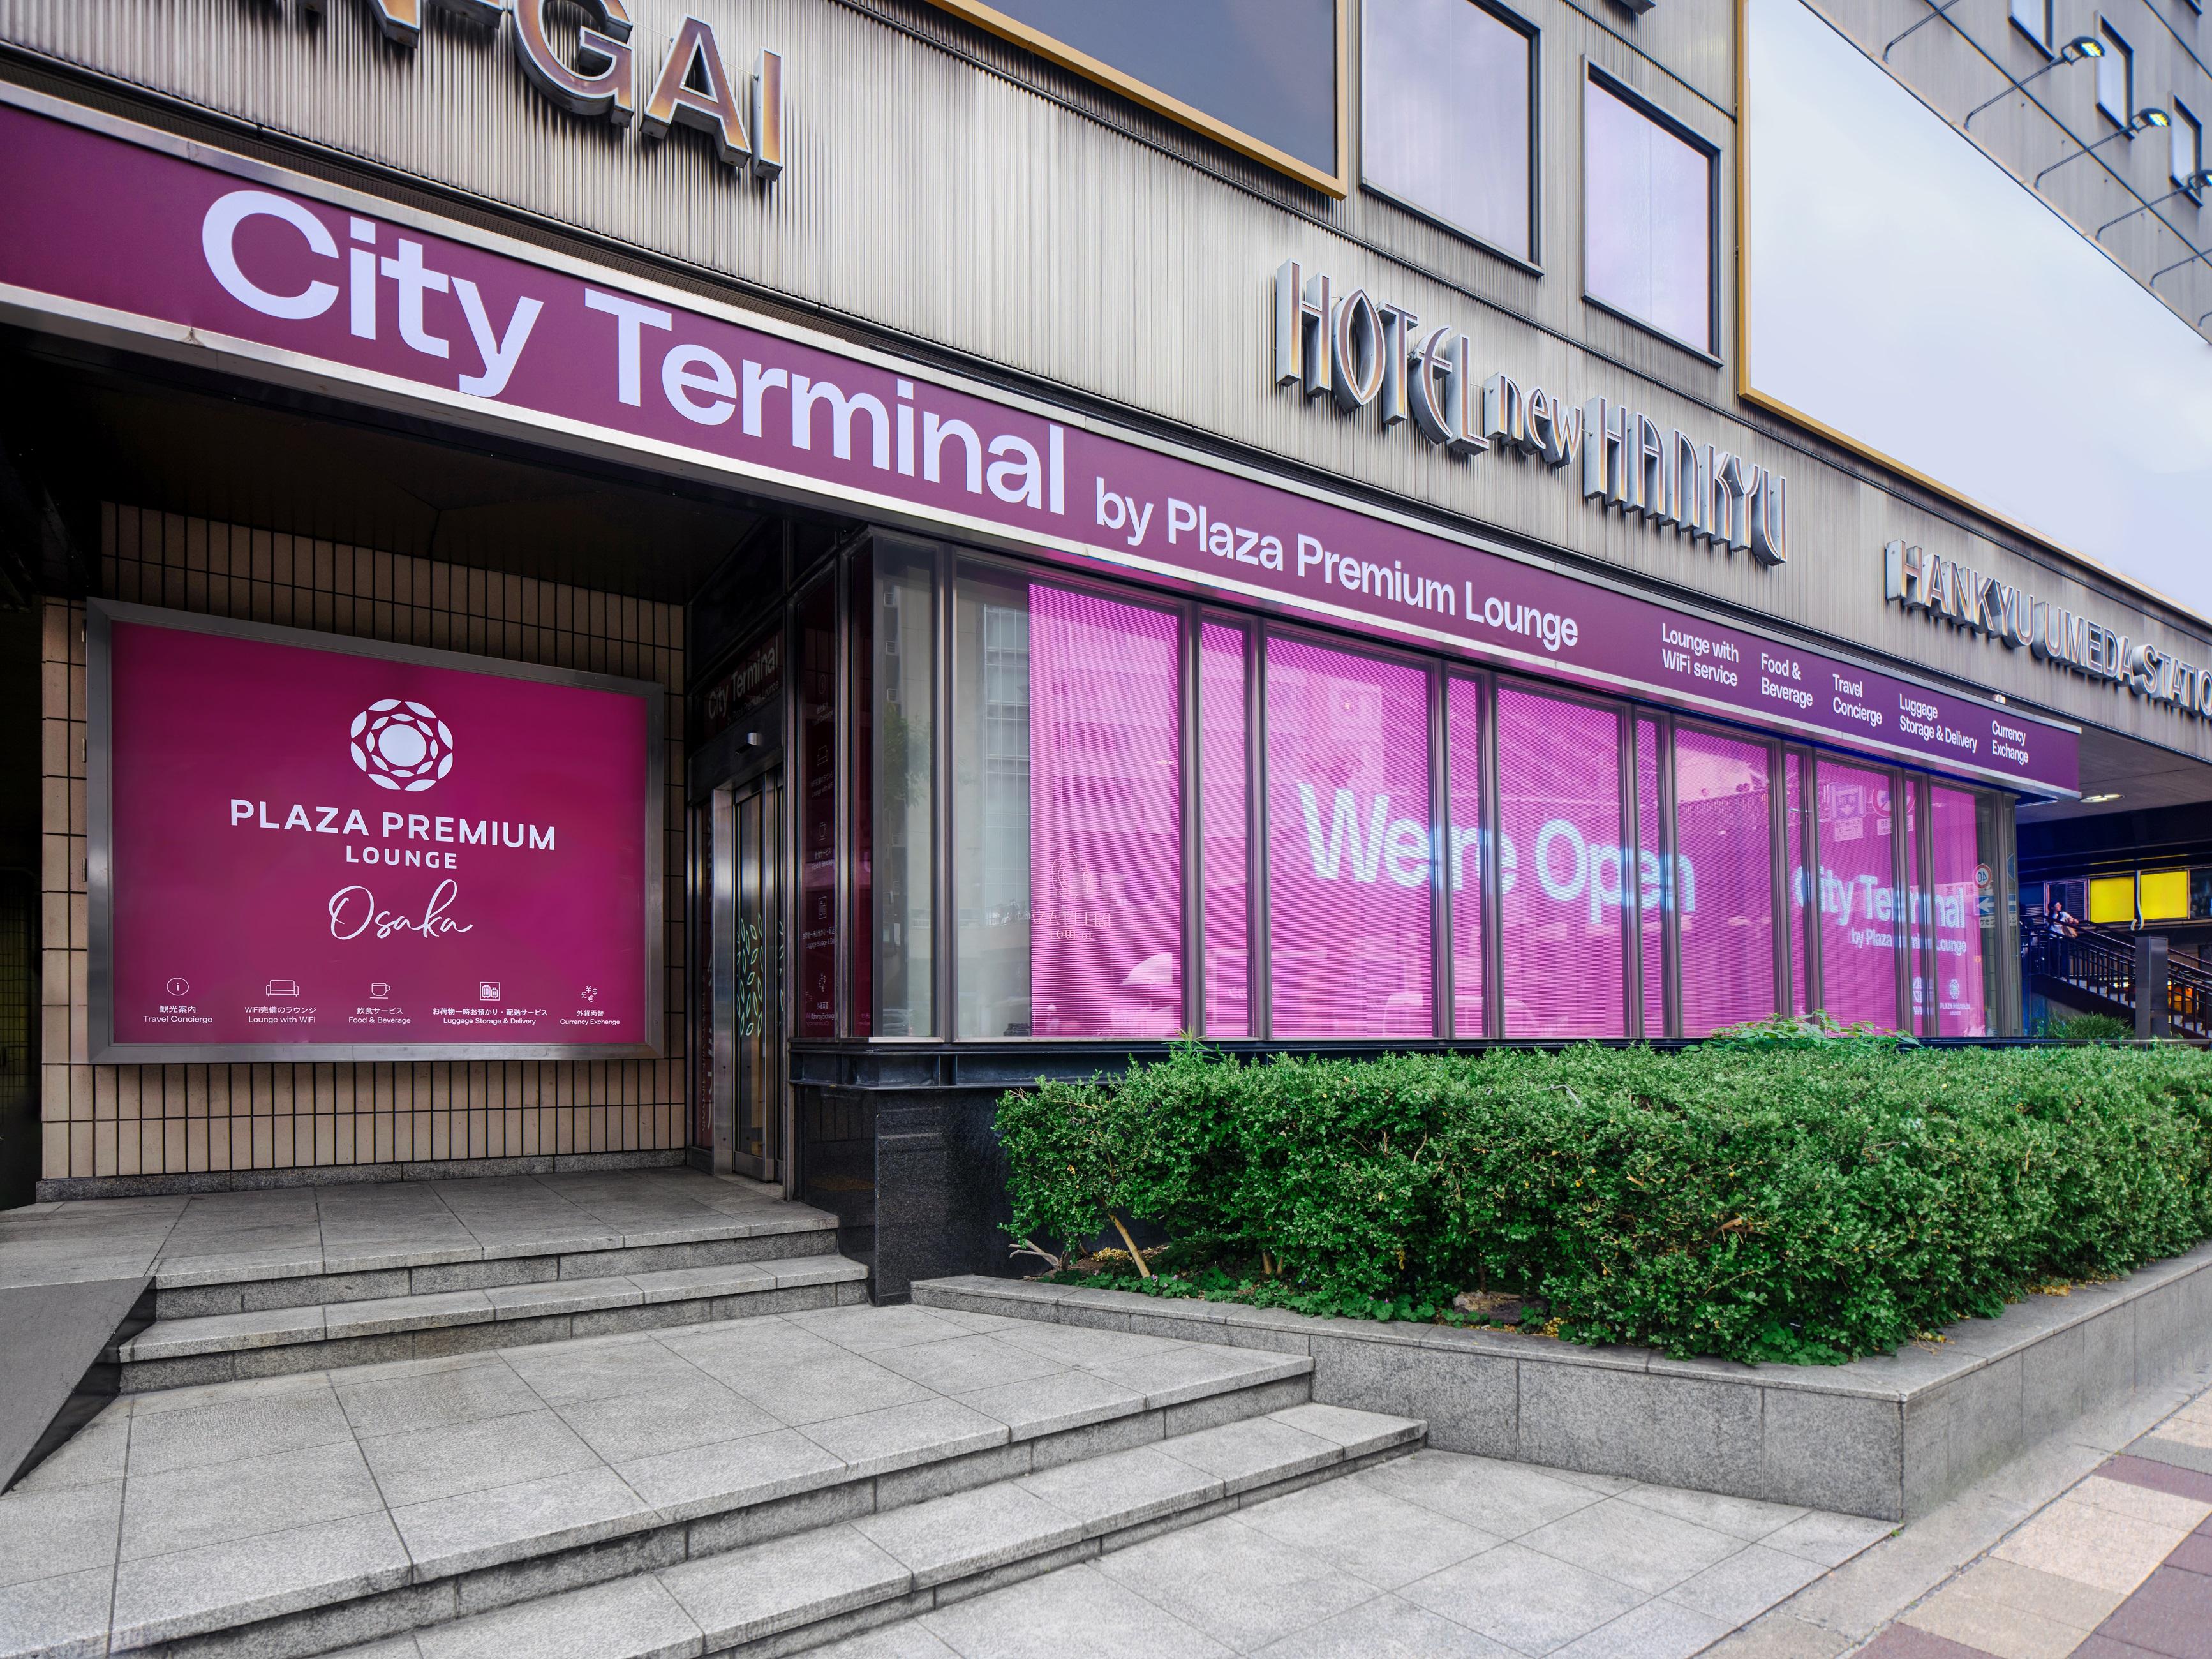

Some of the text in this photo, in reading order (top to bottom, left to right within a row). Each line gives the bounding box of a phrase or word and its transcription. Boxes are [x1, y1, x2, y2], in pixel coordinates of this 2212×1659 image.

[202, 190, 1578, 651] City Terminal by Plaza Premium Lounge
[1276, 258, 1787, 566] HOTEL new HANKYU
[1885, 539, 2035, 648] HANKYU
[2034, 600, 2135, 688] UMEDA
[1662, 623, 1739, 664] Lounge with
[709, 684, 729, 719] City
[731, 635, 779, 702] Terminal
[1662, 648, 1738, 687] WiFi service
[1761, 653, 1802, 681] Food &
[1761, 678, 1813, 709] Beverage
[1832, 674, 1863, 698] Travel
[1832, 696, 1882, 727] Concierge
[1899, 694, 1938, 720] Luggage
[1899, 717, 1977, 754] Storage & Delivery
[1991, 720, 2026, 747] Currency
[1991, 740, 2029, 765] Exchange
[230, 798, 556, 851] PLAZA PREMIUM
[346, 845, 458, 870] LOUNGE
[328, 878, 473, 941] Osaka
[1850, 927, 1864, 949] by
[159, 1005, 196, 1013] 観光案内
[170, 1015, 213, 1024] Concierge
[248, 1016, 278, 1024] Lounge
[377, 1016, 411, 1025] Beverage
[443, 1017, 473, 1025] Luggage
